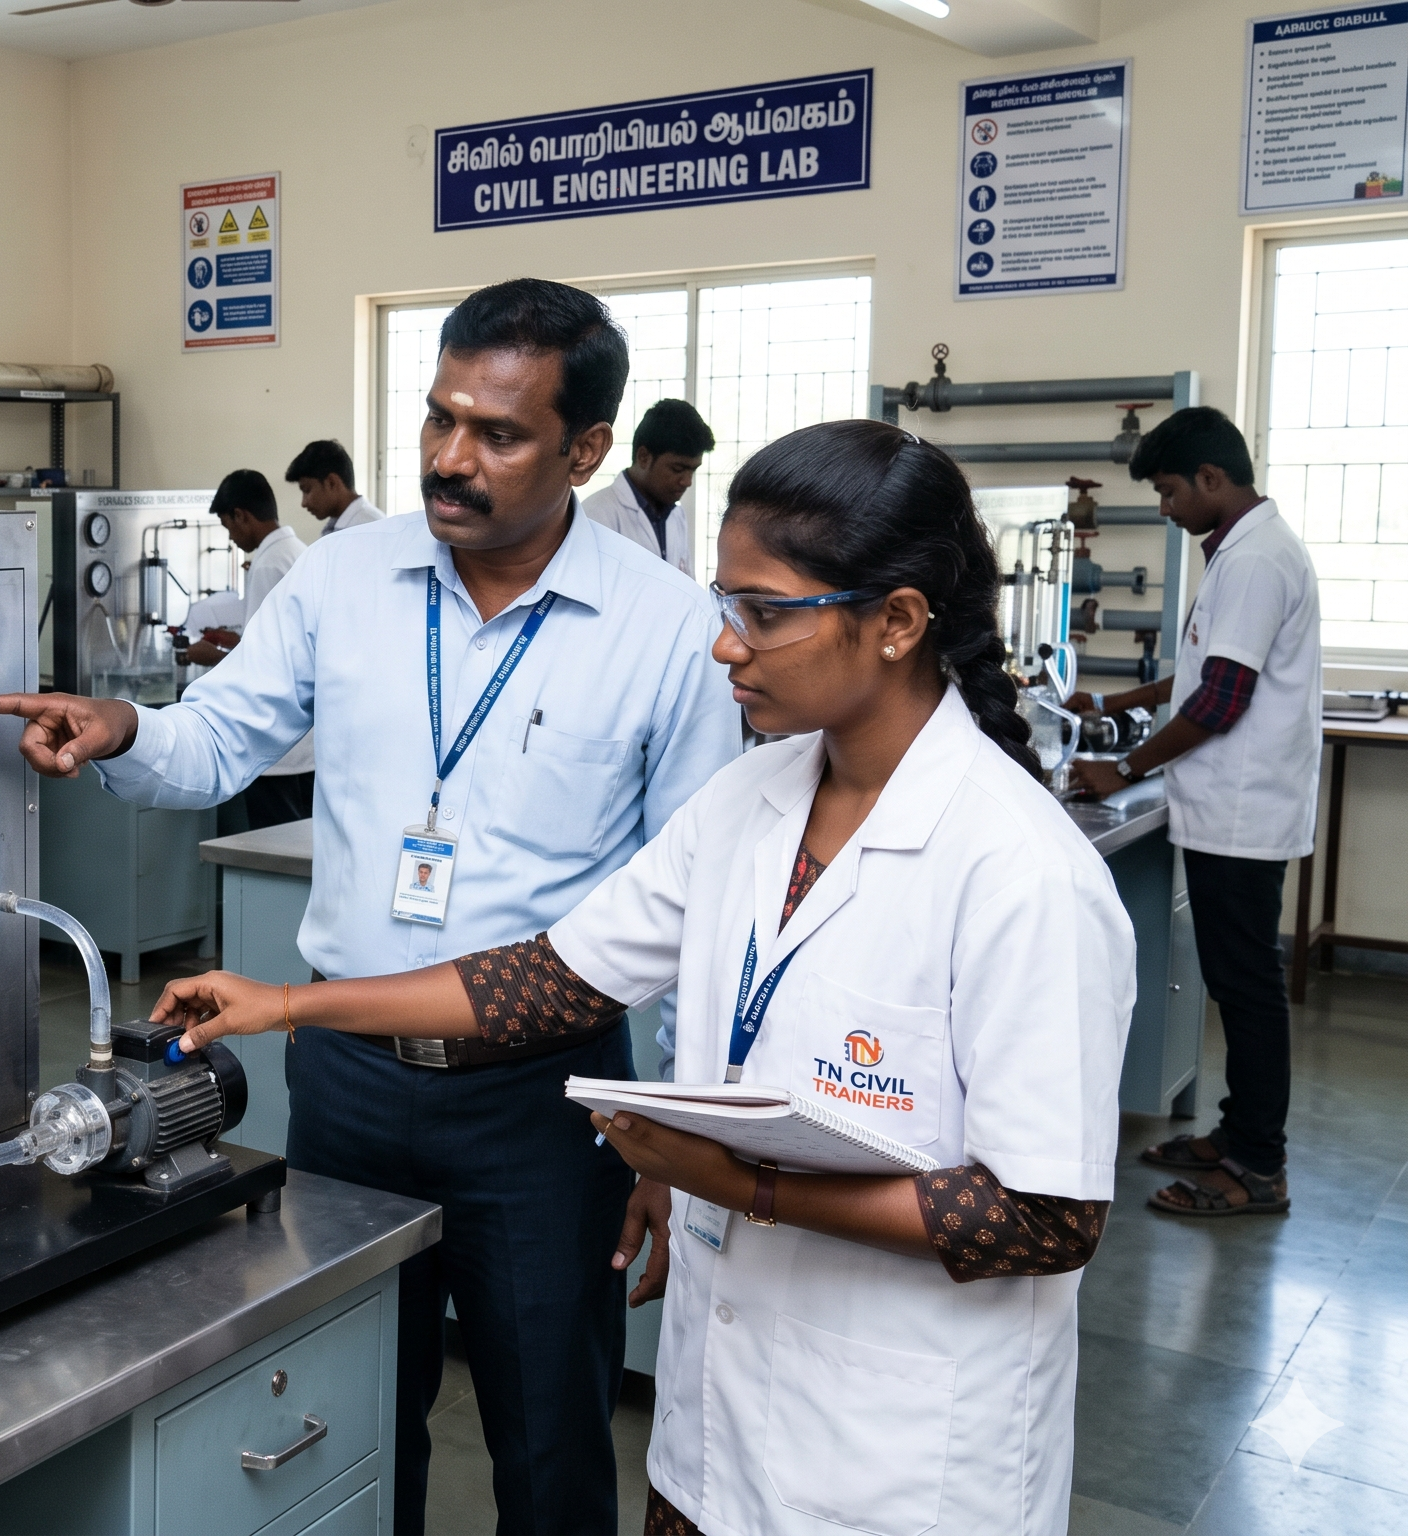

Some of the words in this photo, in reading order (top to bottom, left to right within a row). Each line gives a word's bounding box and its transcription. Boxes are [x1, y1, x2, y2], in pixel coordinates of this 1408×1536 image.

[446, 134, 524, 174] சிவில்
[529, 109, 697, 167] பொறியியல்
[703, 88, 856, 146] ஆய்வகம்
[473, 177, 544, 214] CIVIL
[553, 154, 749, 206] ENGINEERING
[759, 146, 821, 184] LAB
[812, 1077, 914, 1112] TRAINERS
[813, 1057, 842, 1083] TN
[850, 1071, 914, 1096] CIVIL
